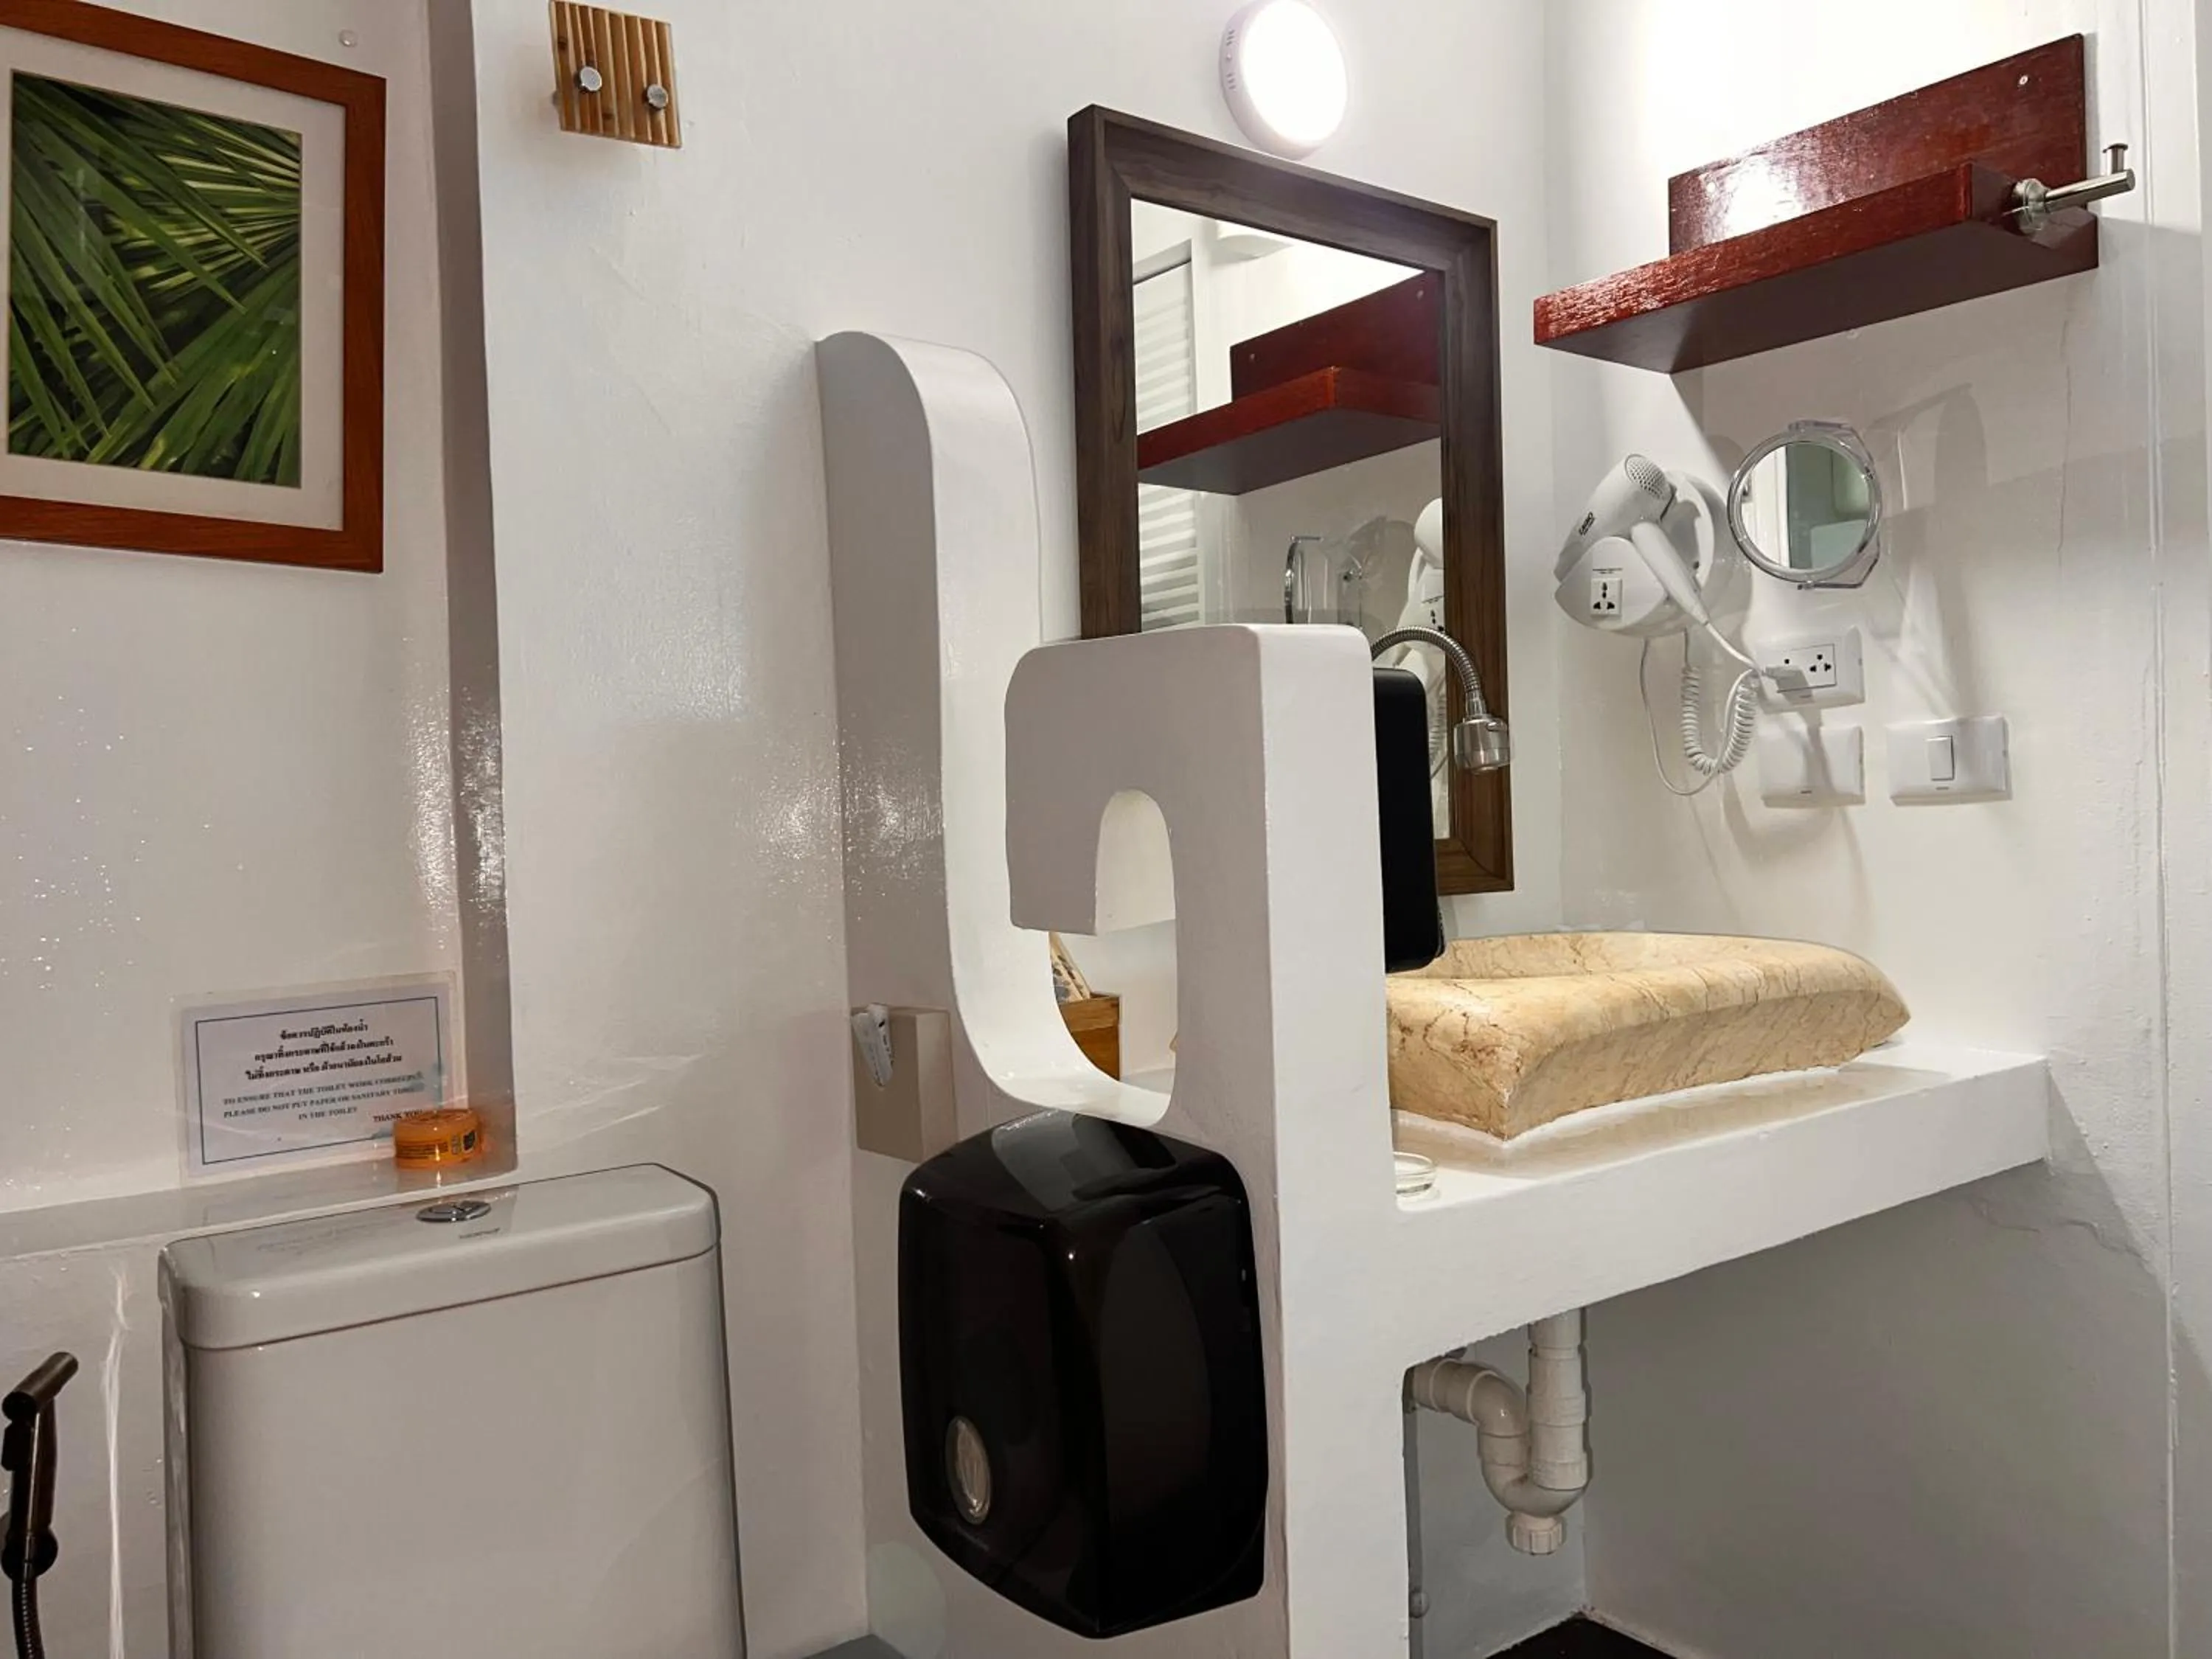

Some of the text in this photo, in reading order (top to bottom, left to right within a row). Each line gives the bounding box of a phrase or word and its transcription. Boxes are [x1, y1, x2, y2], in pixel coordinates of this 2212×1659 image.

[237, 1093, 270, 1103] ENSURE
[273, 1089, 295, 1098] THAT
[298, 1086, 313, 1095] THE
[316, 1082, 346, 1093] TOILET
[223, 1107, 256, 1119] PLEASE
[291, 1101, 307, 1110] PUT
[310, 1096, 336, 1106] PAPER
[338, 1094, 349, 1102] OR
[351, 1090, 390, 1100] SANITARY
[329, 1107, 357, 1116] TOILET
[373, 1113, 403, 1121] THANK
